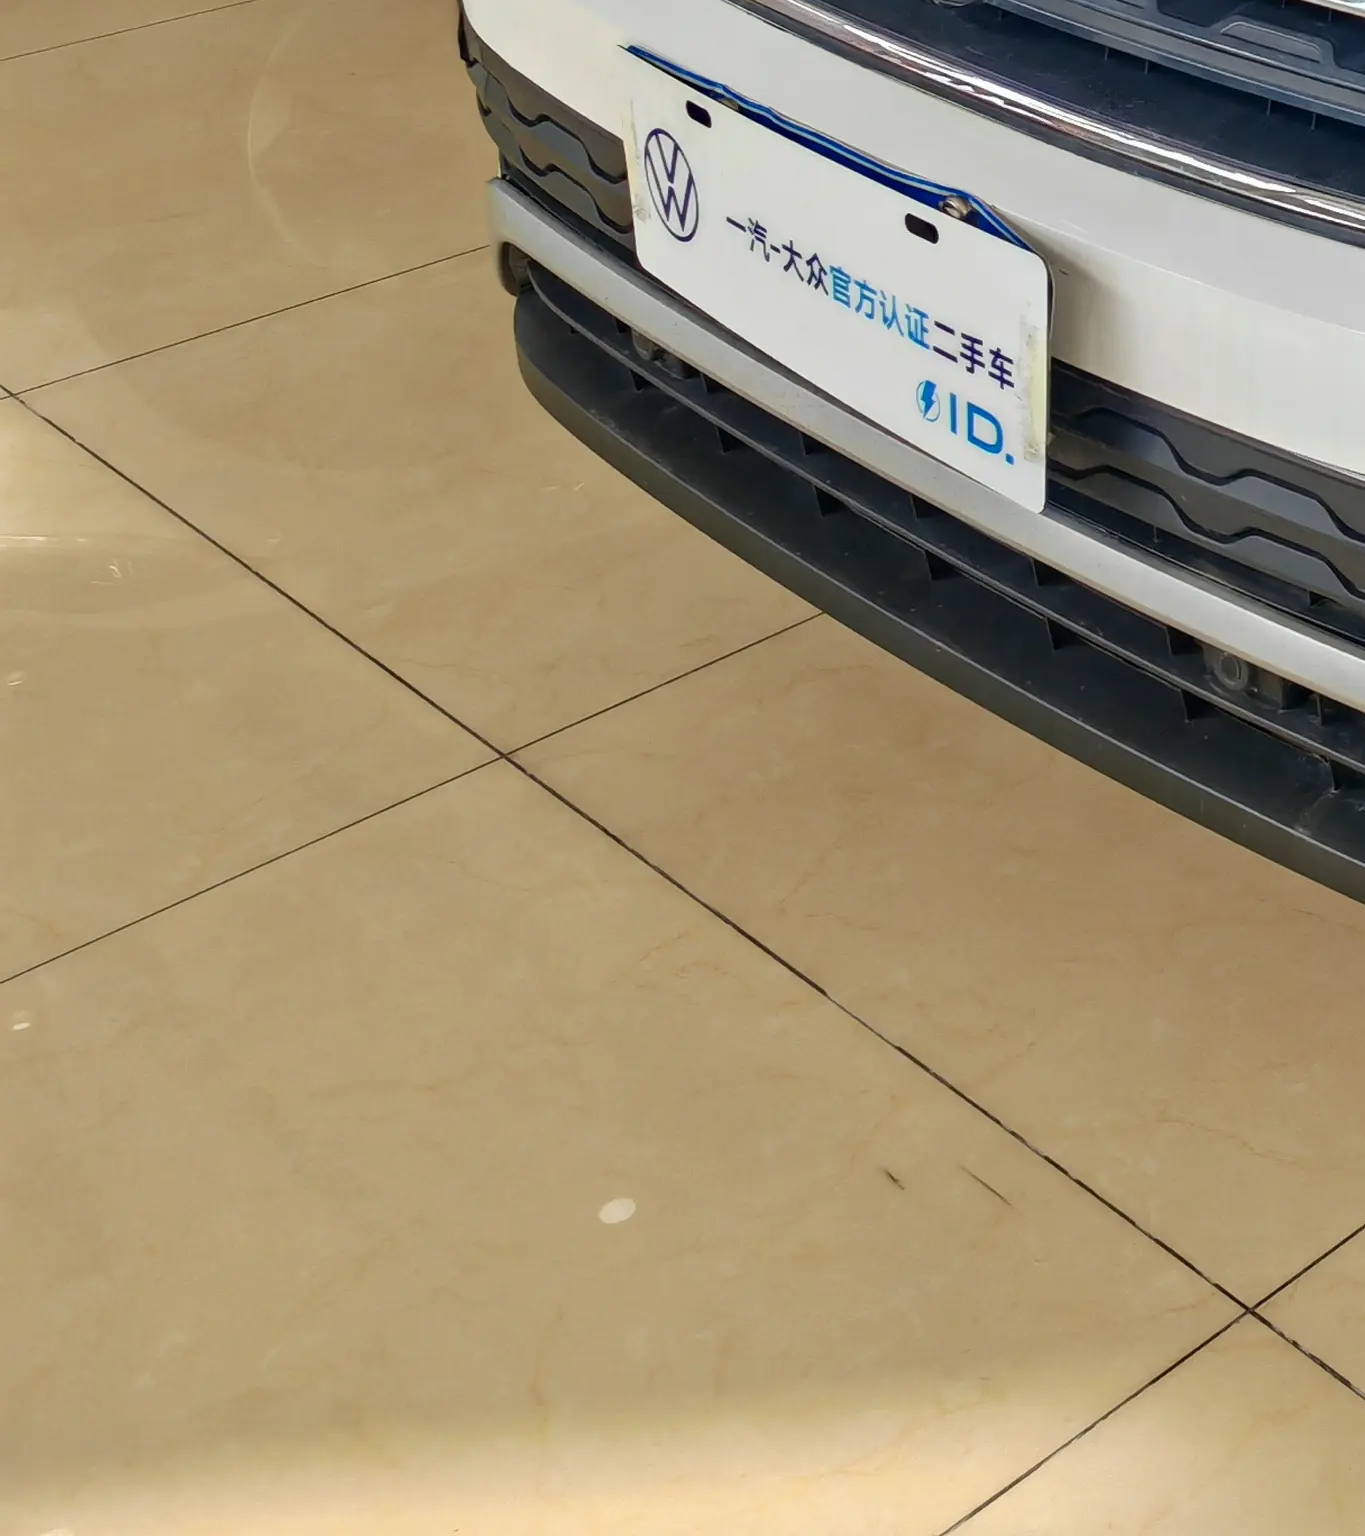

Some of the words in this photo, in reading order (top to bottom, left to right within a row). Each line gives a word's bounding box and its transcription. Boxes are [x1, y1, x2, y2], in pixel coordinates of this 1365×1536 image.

[726, 216, 1016, 390] 一汽-大众官方认证二手车
[949, 392, 1016, 466] ID.
